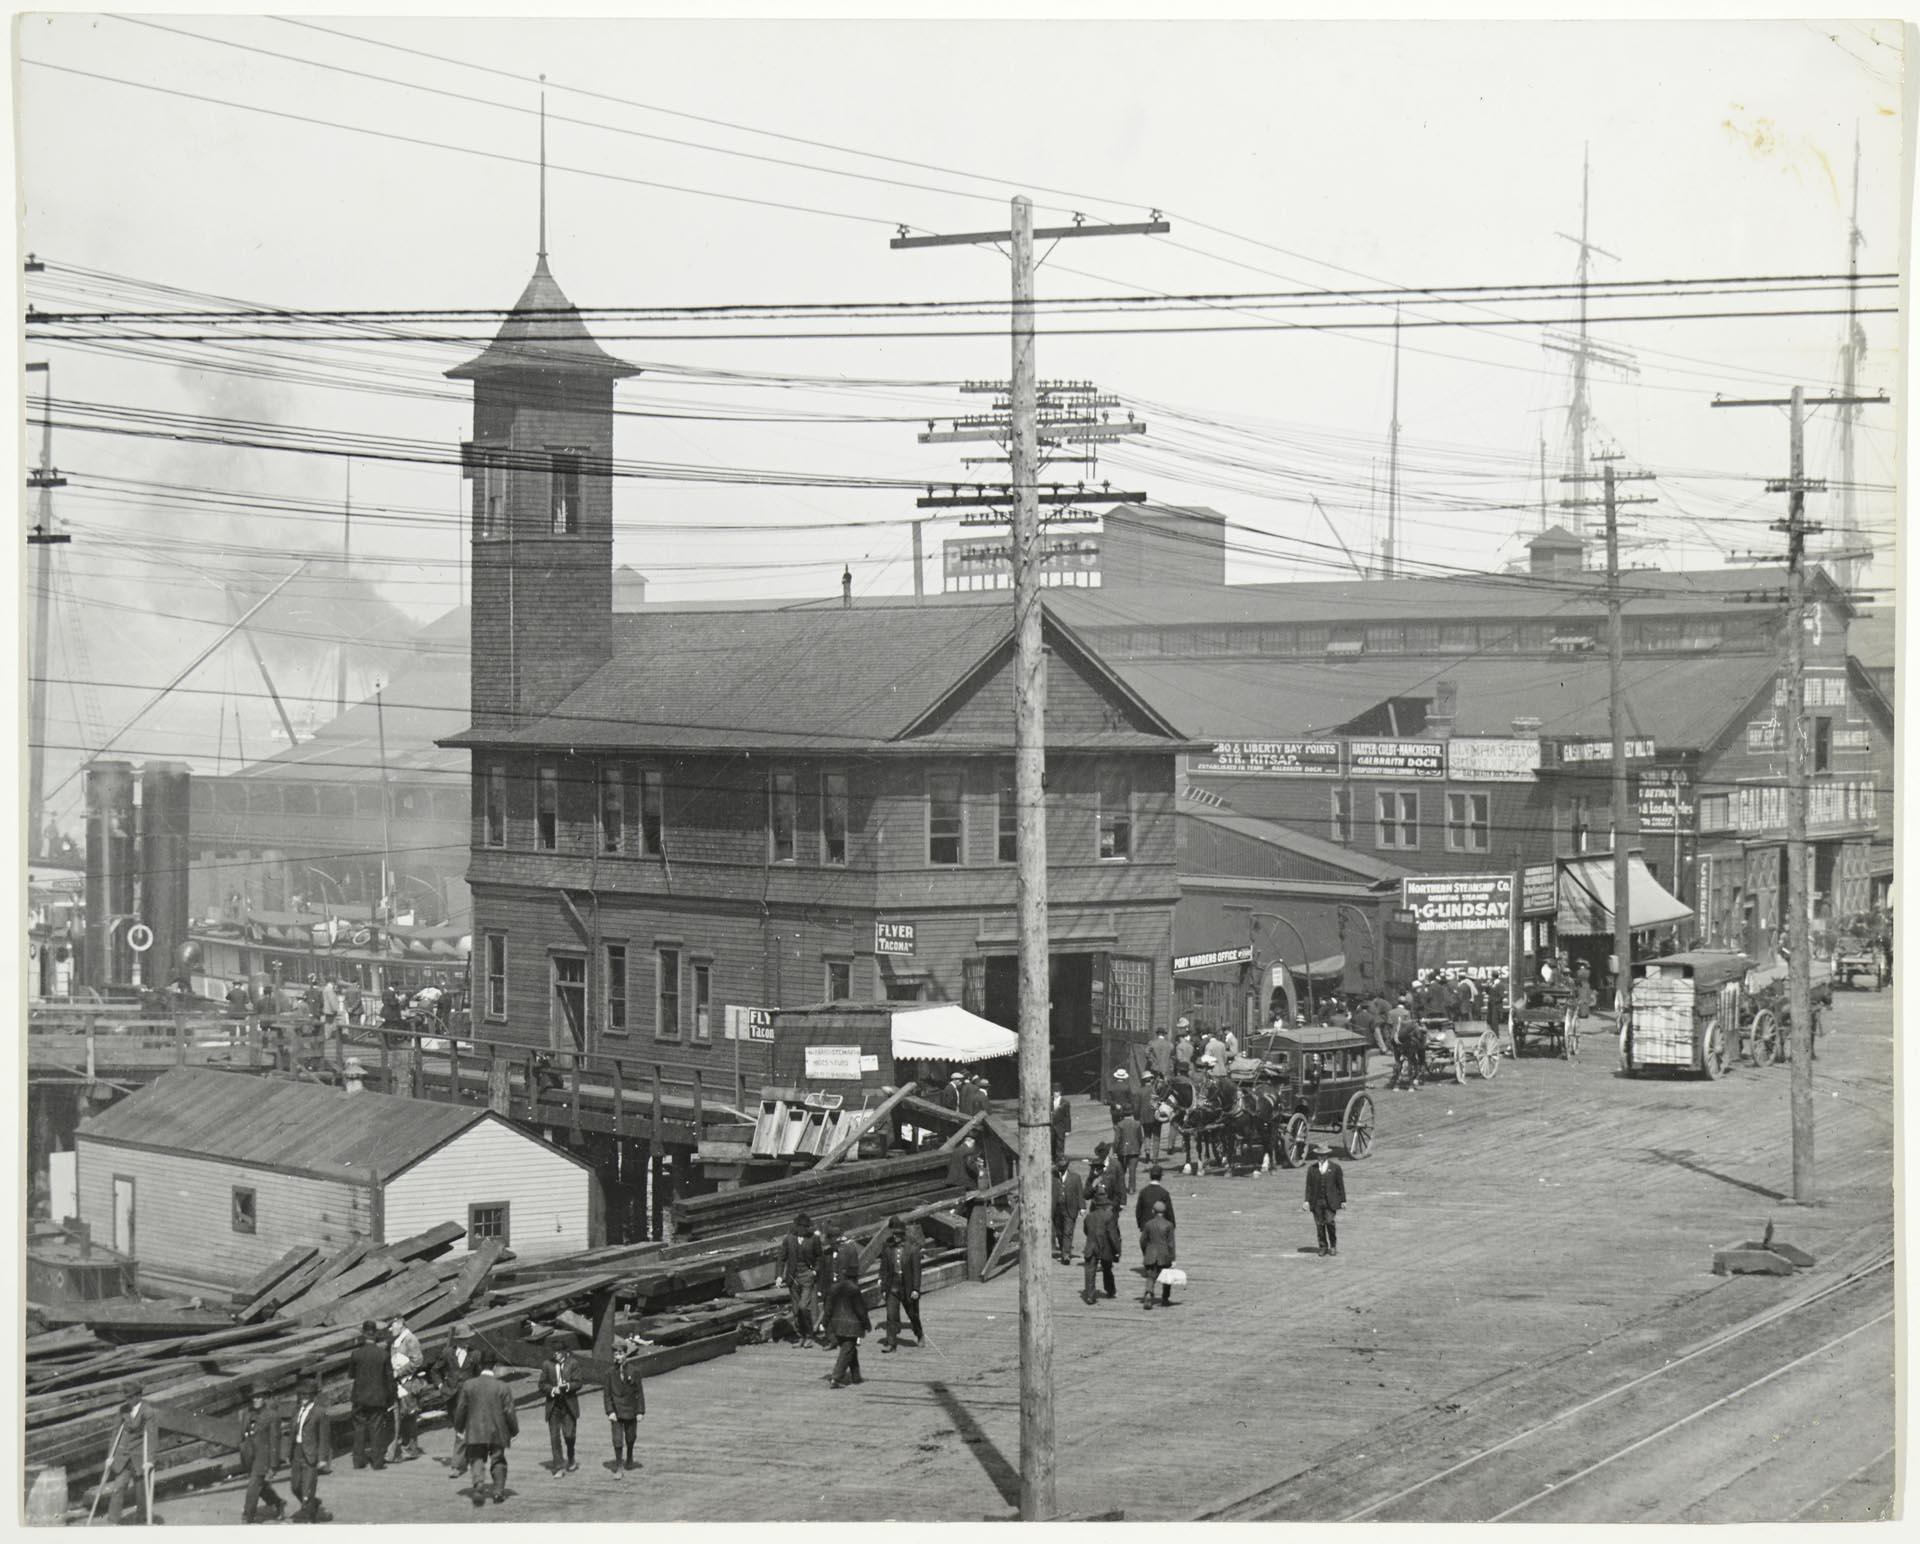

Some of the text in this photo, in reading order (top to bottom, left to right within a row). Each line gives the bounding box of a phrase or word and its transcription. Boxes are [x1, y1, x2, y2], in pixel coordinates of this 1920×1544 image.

[1244, 743, 1282, 754] LIBERTY
[1284, 744, 1303, 754] BAY
[1304, 744, 1336, 755] POINTS
[1357, 756, 1405, 767] GALBRAITH
[1407, 758, 1438, 768] DOCK
[1408, 883, 1453, 894] NORTHERN
[1453, 882, 1496, 893] STEAMSHIP
[878, 923, 914, 939] FLYER
[1416, 918, 1462, 931] outhwestern
[1486, 917, 1509, 929] Points
[1174, 956, 1189, 969] PORT
[1189, 952, 1217, 967] WARDENS
[1217, 949, 1238, 962] OFFICE
[750, 1010, 771, 1025] FLY
